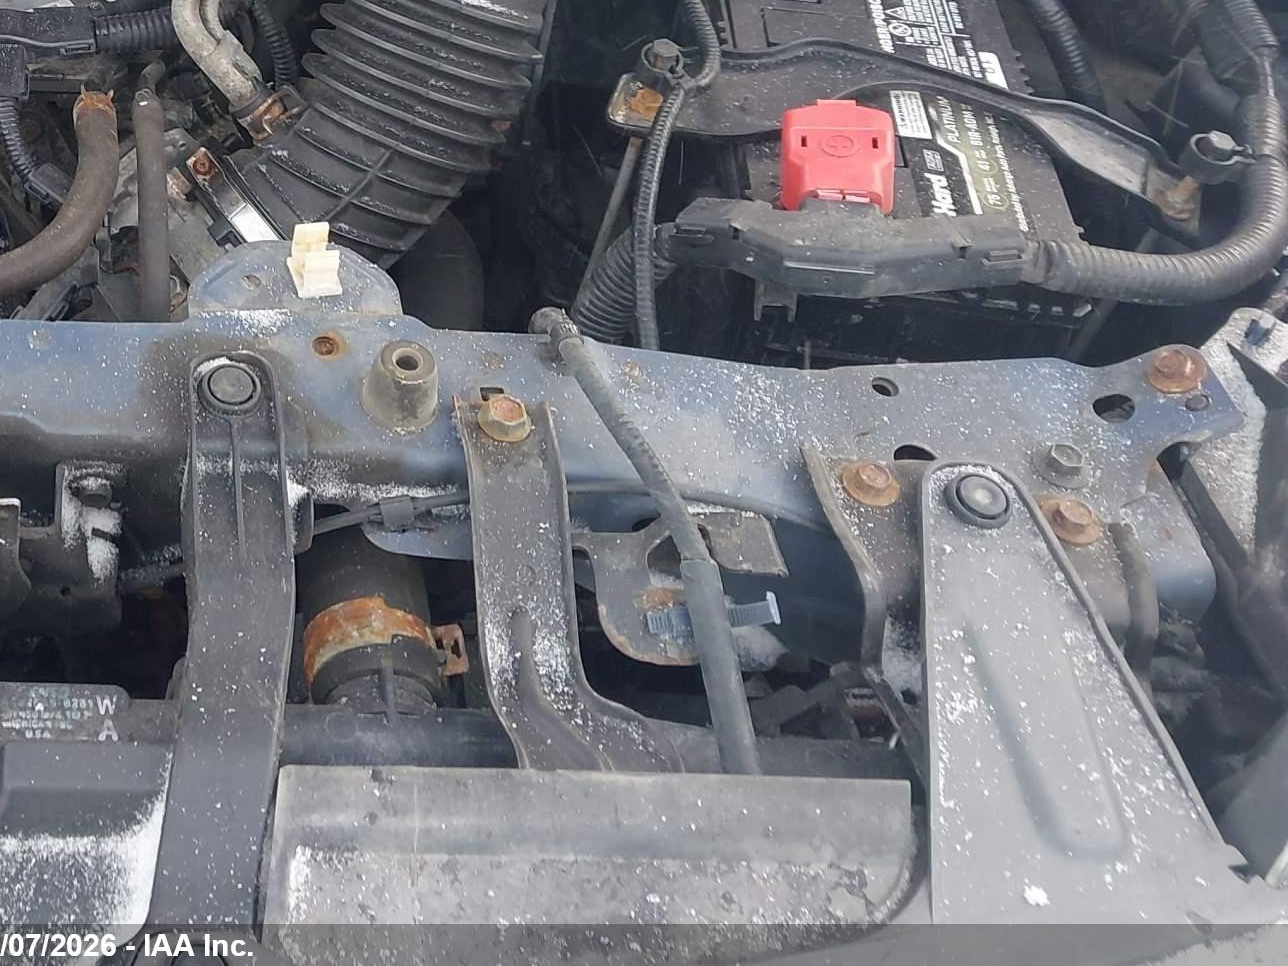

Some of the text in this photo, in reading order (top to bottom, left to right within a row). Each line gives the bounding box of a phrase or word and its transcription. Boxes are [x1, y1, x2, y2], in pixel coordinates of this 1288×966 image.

[936, 95, 961, 144] PLATINUM
[94, 694, 117, 715] W
[97, 719, 119, 742] A
